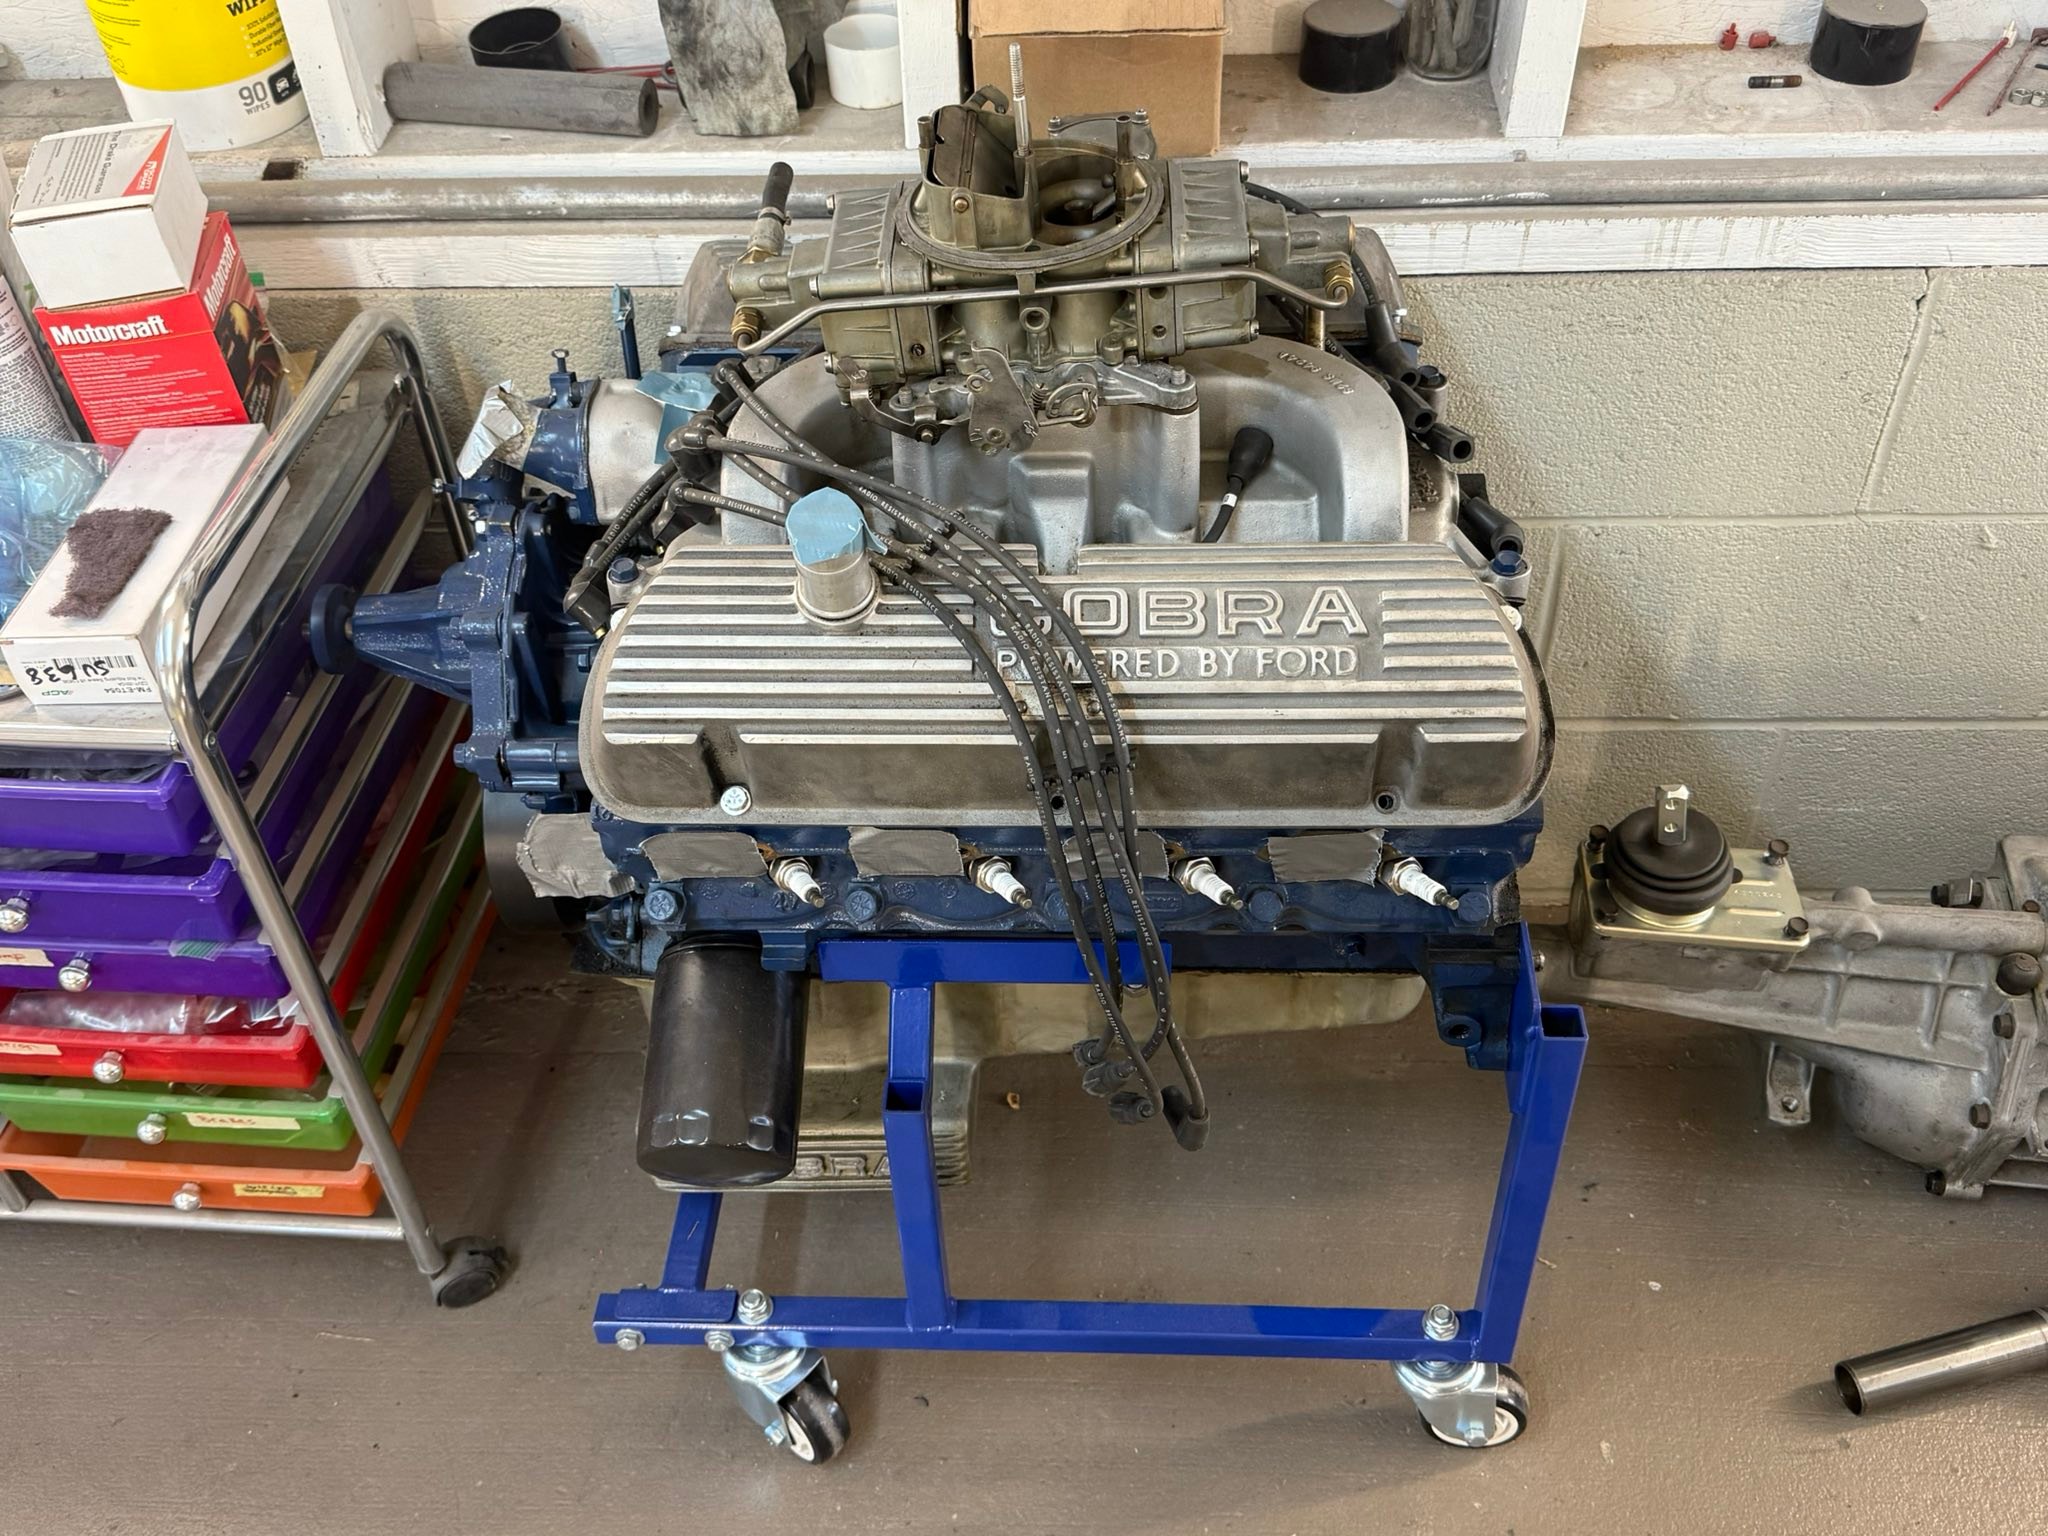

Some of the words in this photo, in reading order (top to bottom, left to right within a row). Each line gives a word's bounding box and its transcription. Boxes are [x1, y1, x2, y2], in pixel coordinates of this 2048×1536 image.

[238, 81, 268, 107] 90
[245, 101, 271, 115] WIPES
[104, 143, 118, 161] Drake
[203, 232, 237, 322] Motorcraft
[50, 315, 169, 346] Motorcraft
[901, 578, 940, 615] RESISTANCE
[1010, 624, 1030, 651] RADIO
[1029, 655, 1056, 710] RESISTANCE
[1199, 648, 1238, 679] BY
[1256, 647, 1358, 678] FORD
[858, 485, 878, 502] RADIO
[880, 500, 918, 530] RESISTANCE
[1024, 622, 1043, 649] RADIO
[1043, 652, 1072, 704] RESISTANCE
[1118, 867, 1134, 896] RADIO
[1131, 899, 1154, 948] RESISTANCE
[1106, 691, 1128, 748] RESISTANCE
